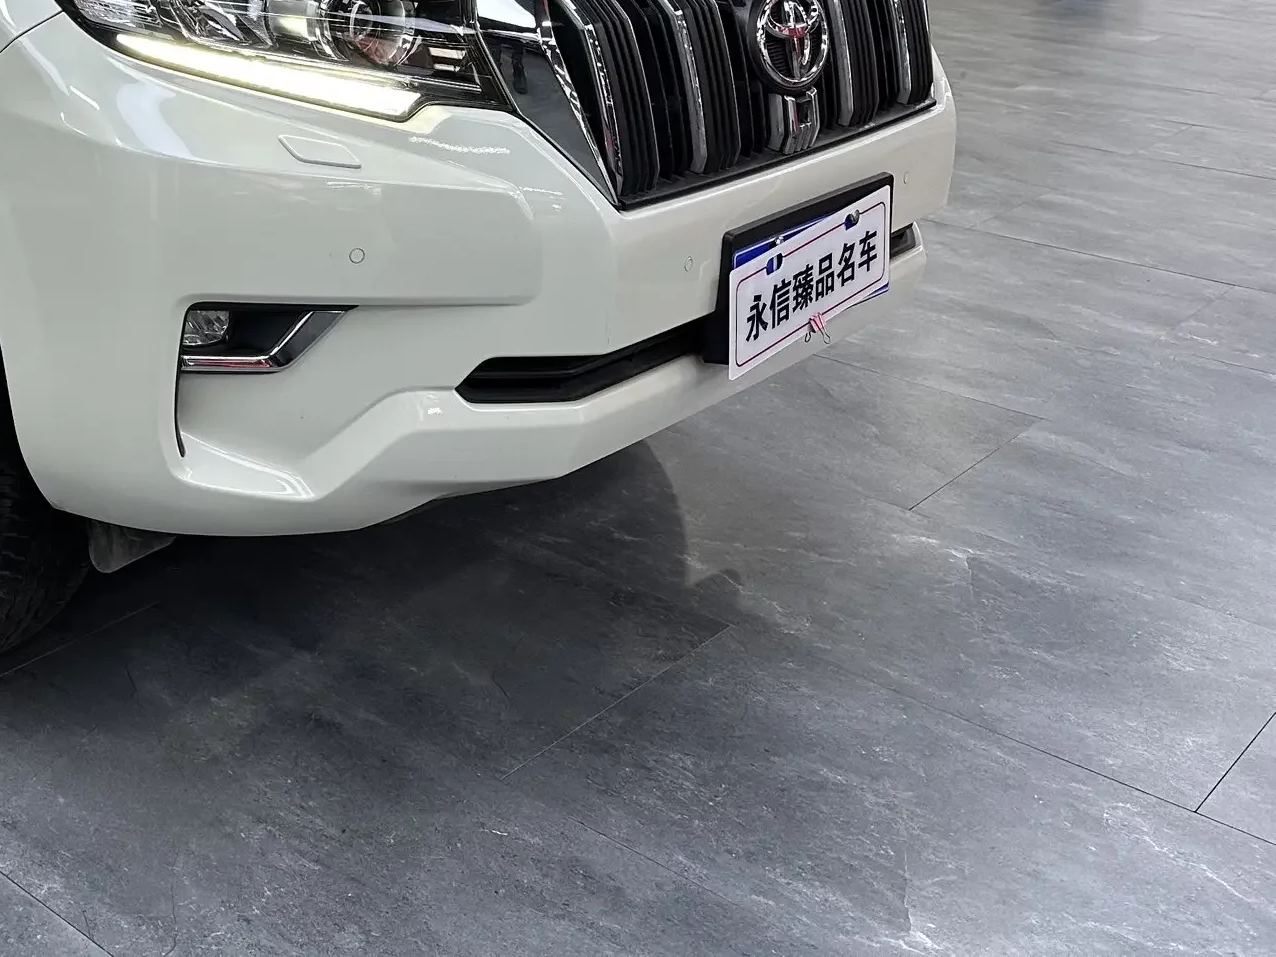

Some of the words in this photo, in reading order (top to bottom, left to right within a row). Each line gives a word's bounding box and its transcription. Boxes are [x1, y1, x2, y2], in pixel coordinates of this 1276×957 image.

[745, 231, 878, 342] 永信臻品名车
